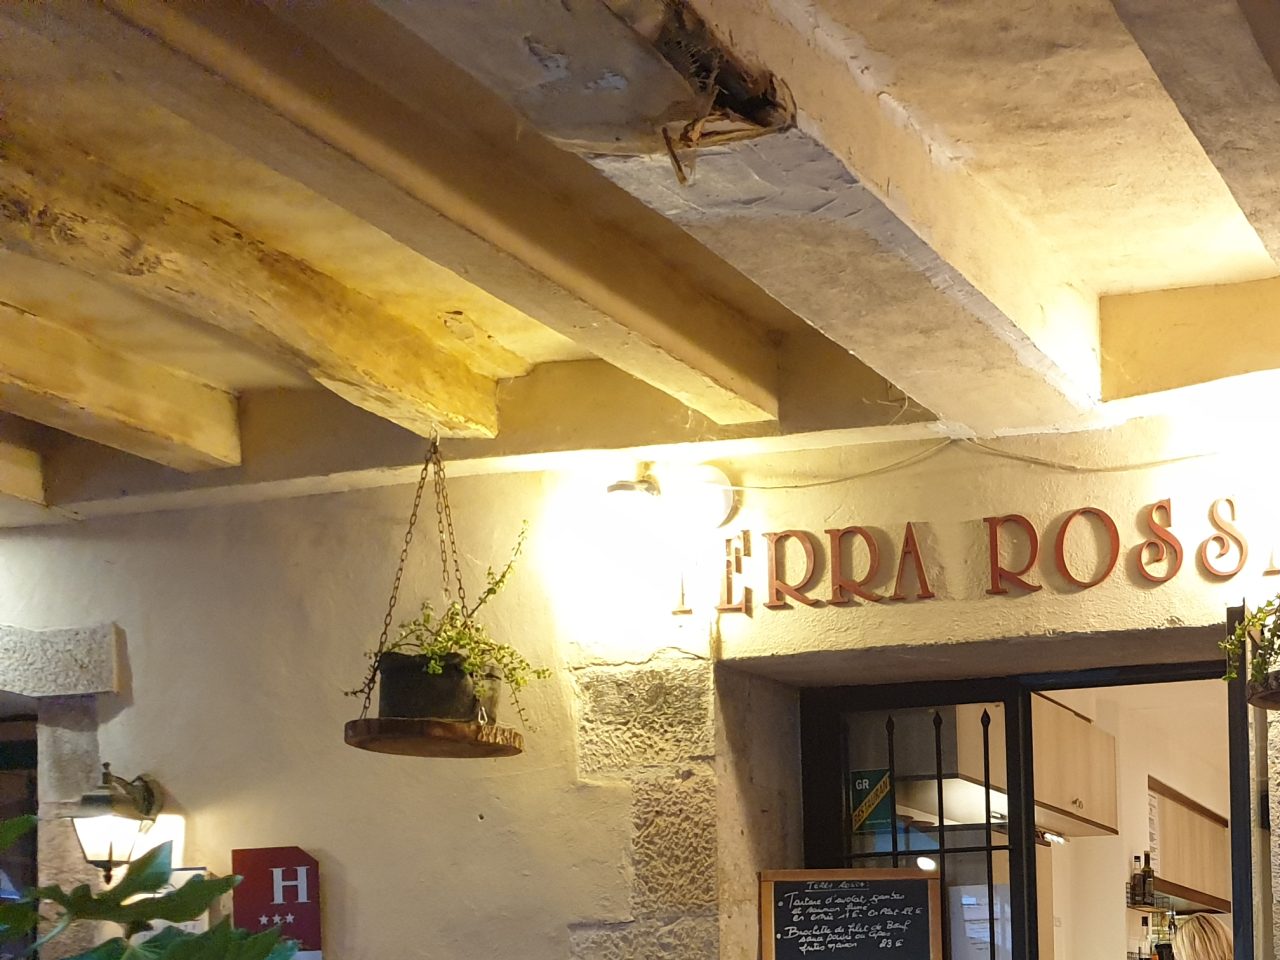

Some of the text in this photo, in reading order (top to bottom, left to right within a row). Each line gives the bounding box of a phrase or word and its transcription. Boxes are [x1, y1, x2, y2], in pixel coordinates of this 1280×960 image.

[671, 528, 935, 618] ERRA
[855, 778, 870, 790] GR
[269, 865, 310, 904] H
